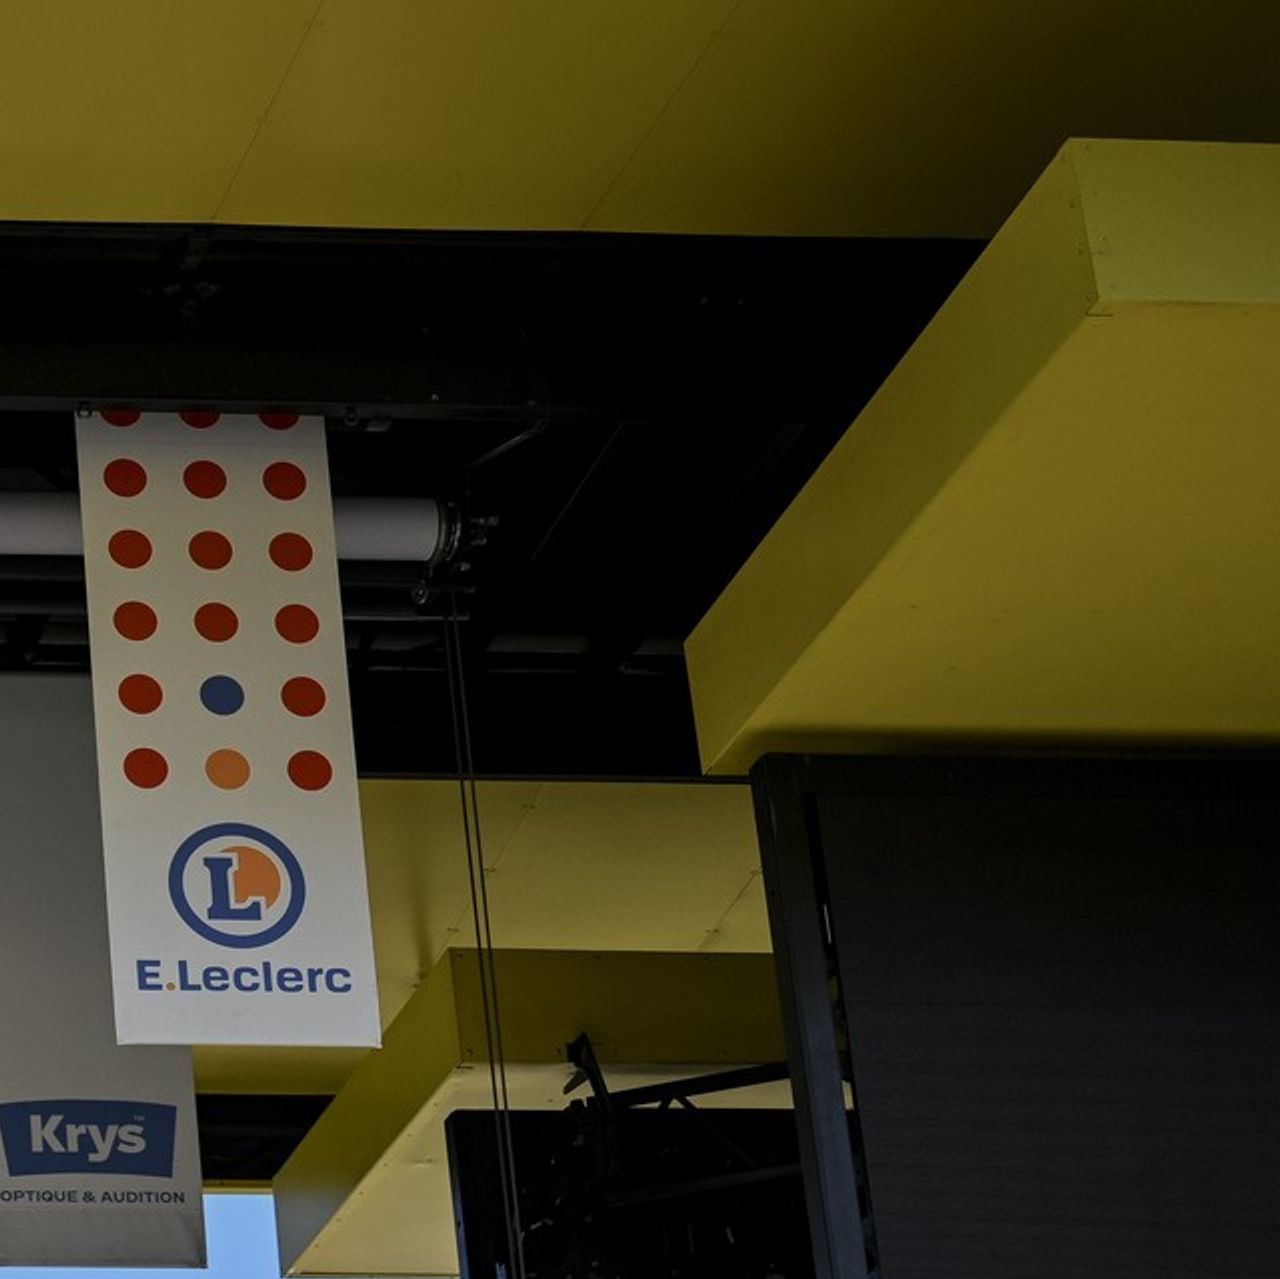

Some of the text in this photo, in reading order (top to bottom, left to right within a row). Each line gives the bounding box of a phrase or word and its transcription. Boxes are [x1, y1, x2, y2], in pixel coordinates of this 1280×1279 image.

[136, 960, 352, 993] E.Leclerc
[30, 1114, 146, 1163] Krys
[0, 1190, 185, 1204] OPTIQUE & AUDITION
